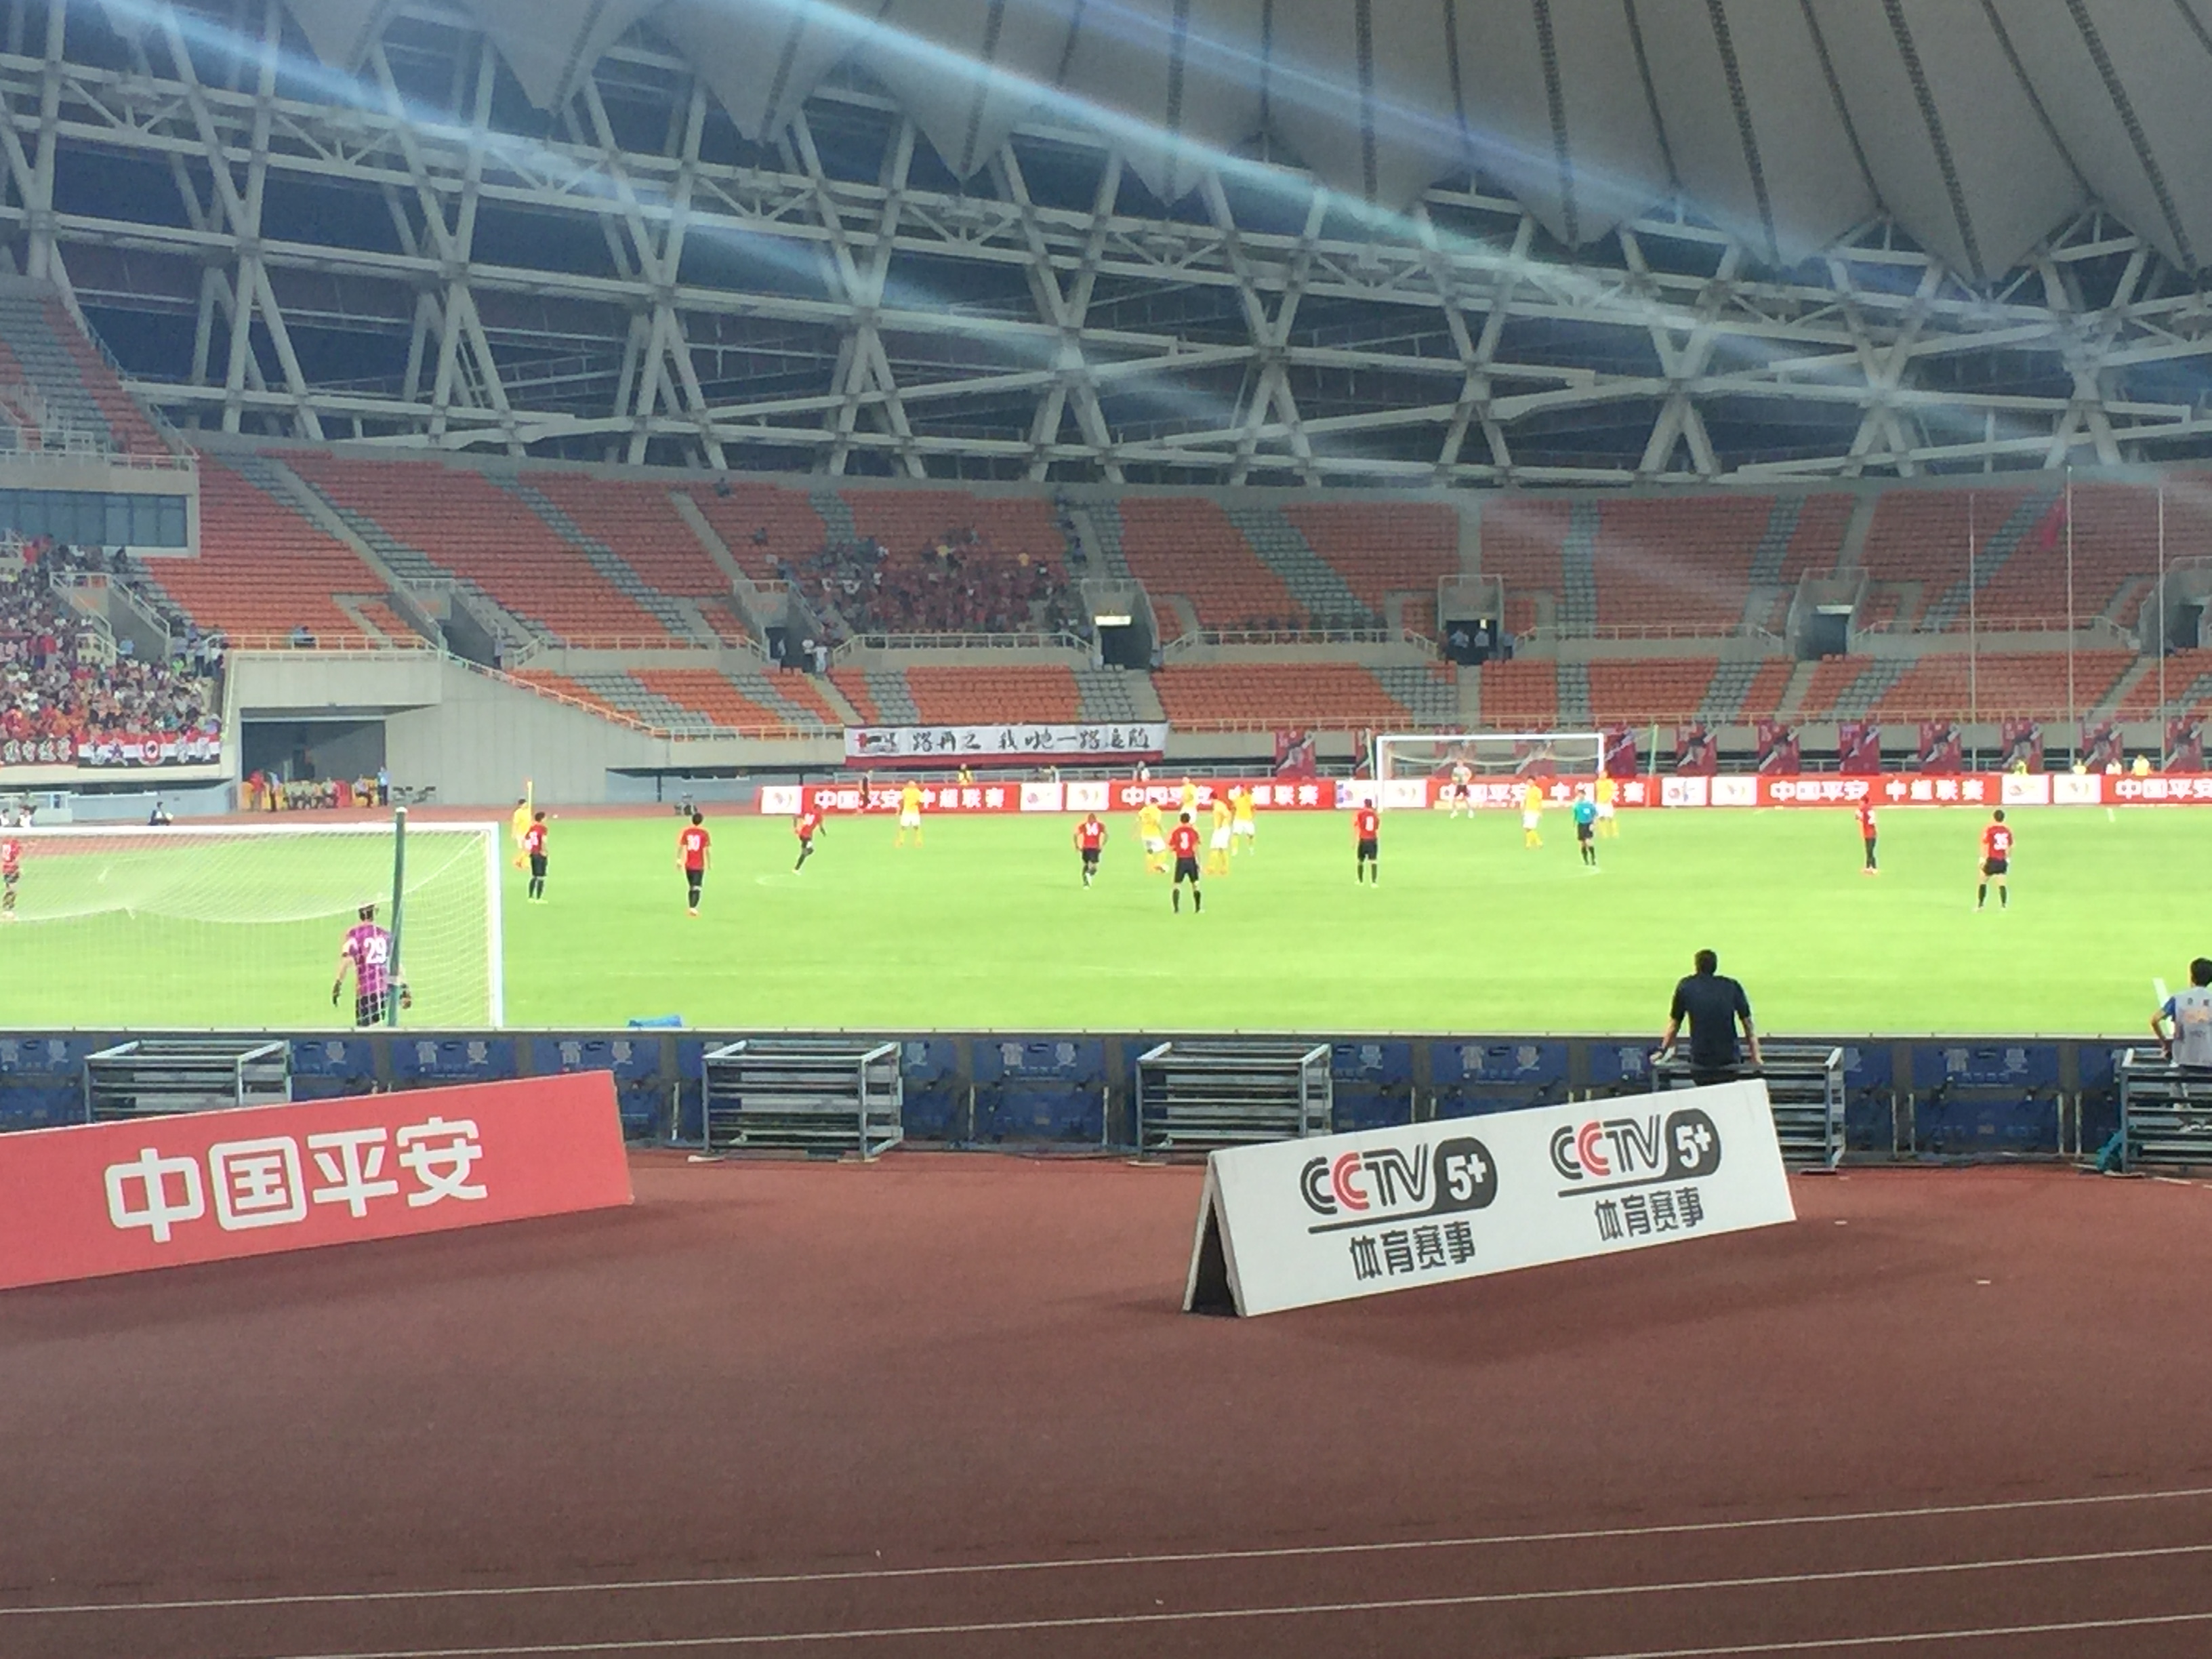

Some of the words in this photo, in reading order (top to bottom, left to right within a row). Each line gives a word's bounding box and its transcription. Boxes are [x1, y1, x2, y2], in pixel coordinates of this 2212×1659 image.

[1769, 780, 1869, 801] 中国平安
[1885, 779, 1984, 801] 中超联赛
[2115, 777, 2212, 800] 中国平安
[363, 937, 387, 964] 29
[104, 1116, 488, 1243] 中国平安
[1594, 1187, 1704, 1242] 体育赛事
[1349, 1221, 1476, 1280] 体育赛事
